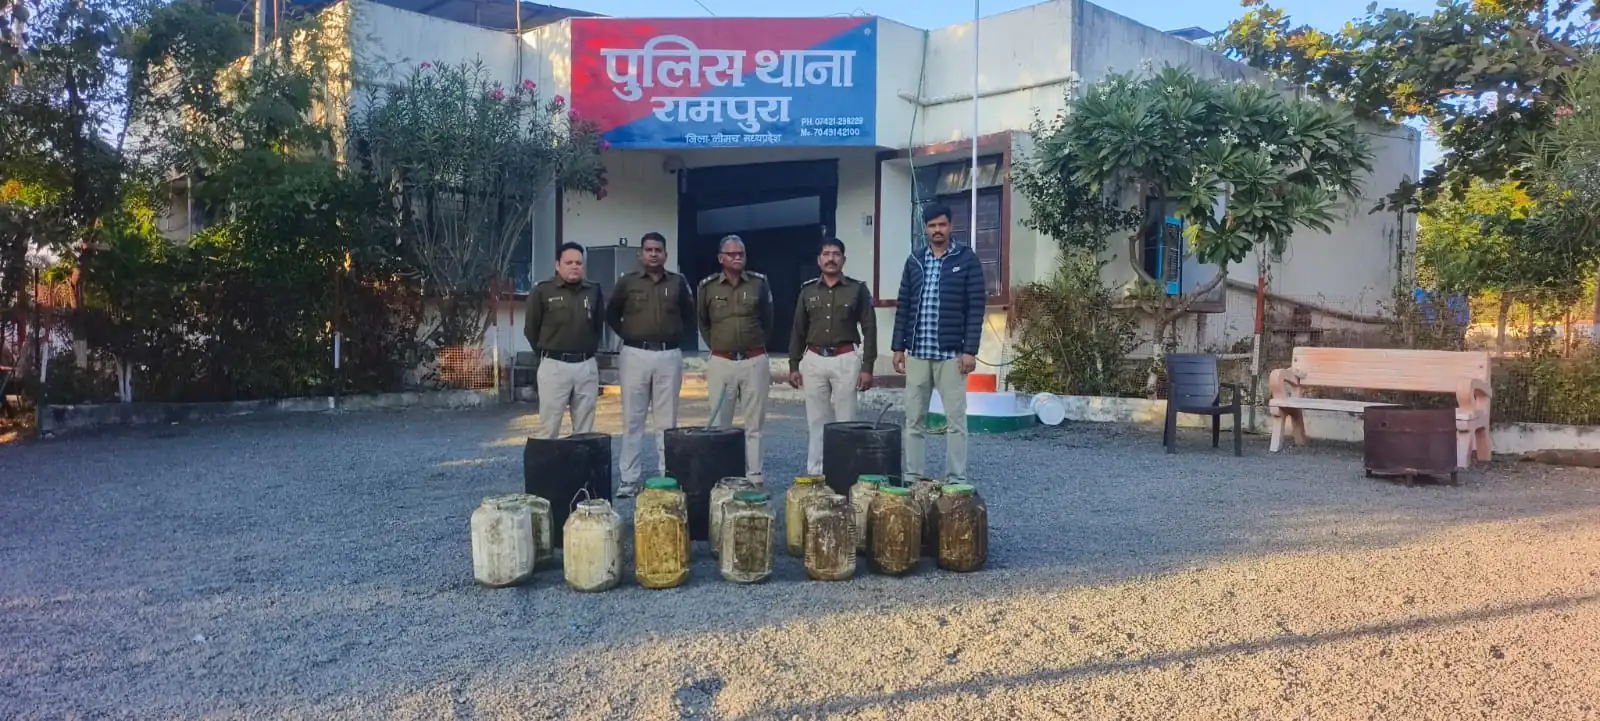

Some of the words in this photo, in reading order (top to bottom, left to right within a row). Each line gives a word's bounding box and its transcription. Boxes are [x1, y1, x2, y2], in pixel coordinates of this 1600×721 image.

[600, 35, 747, 101] पुलिस
[754, 48, 857, 88] थाना
[651, 96, 793, 132] रामपुरा
